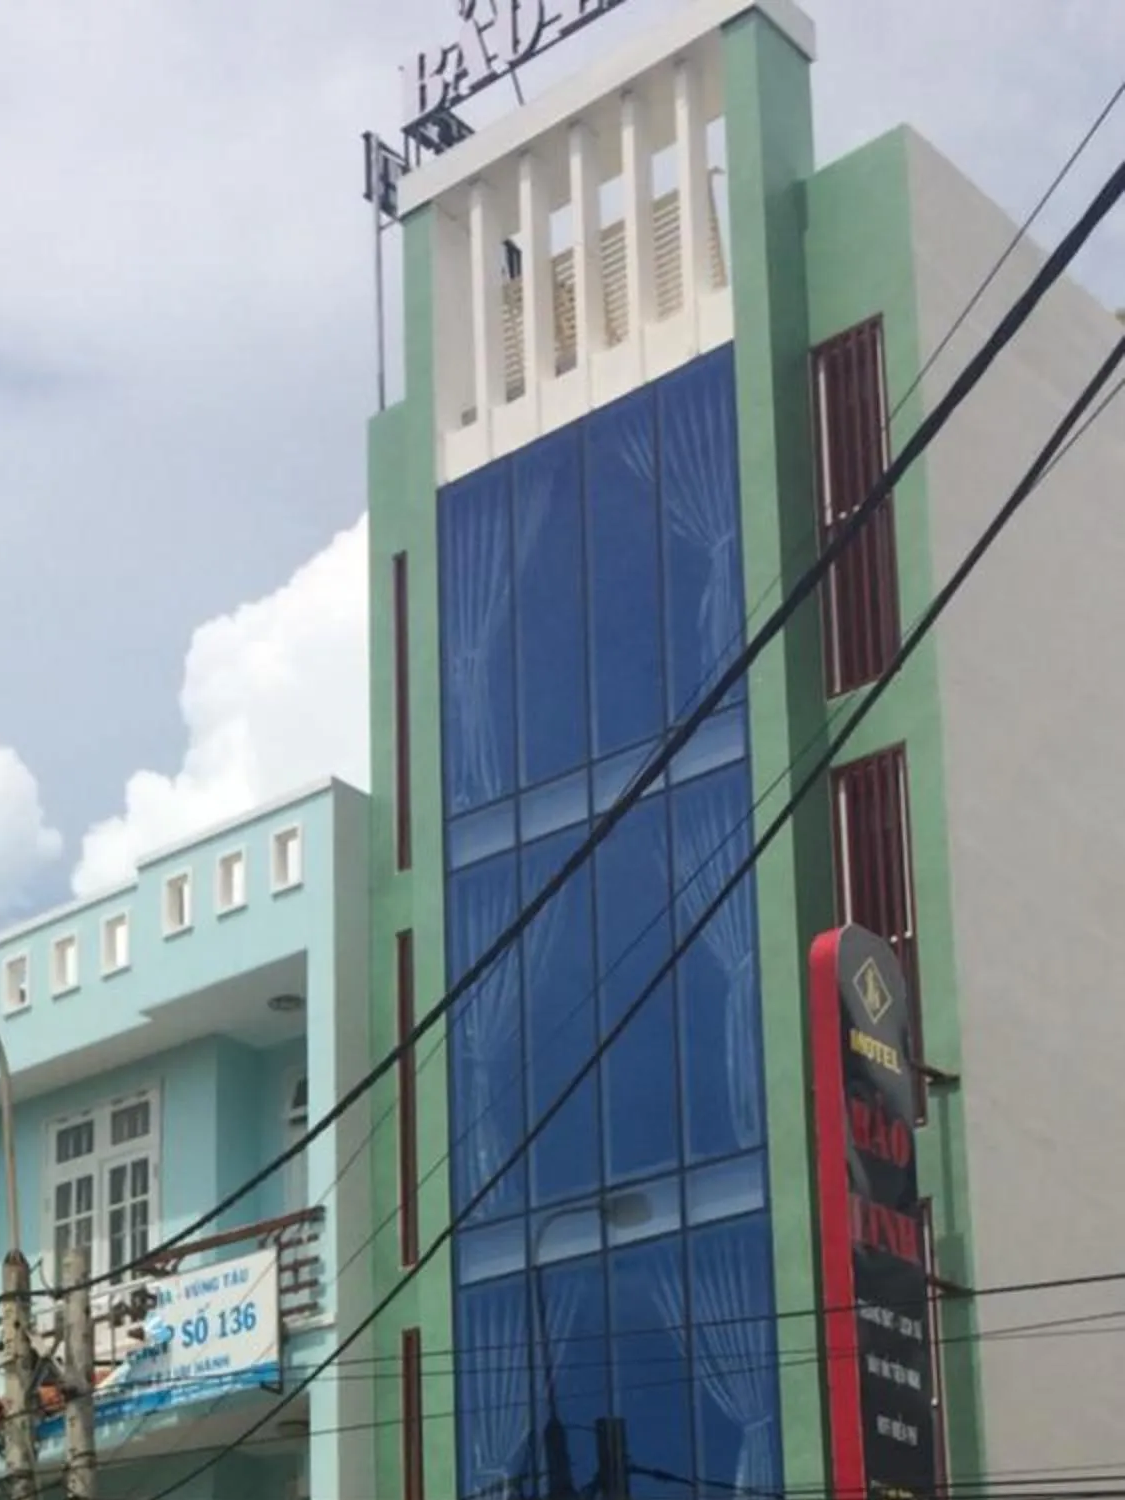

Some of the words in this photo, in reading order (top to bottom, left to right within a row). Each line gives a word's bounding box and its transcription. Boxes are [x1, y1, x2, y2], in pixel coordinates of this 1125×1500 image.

[849, 1028, 902, 1076] MOTEL
[181, 1301, 209, 1348] SỐ
[218, 1301, 257, 1339] 136
